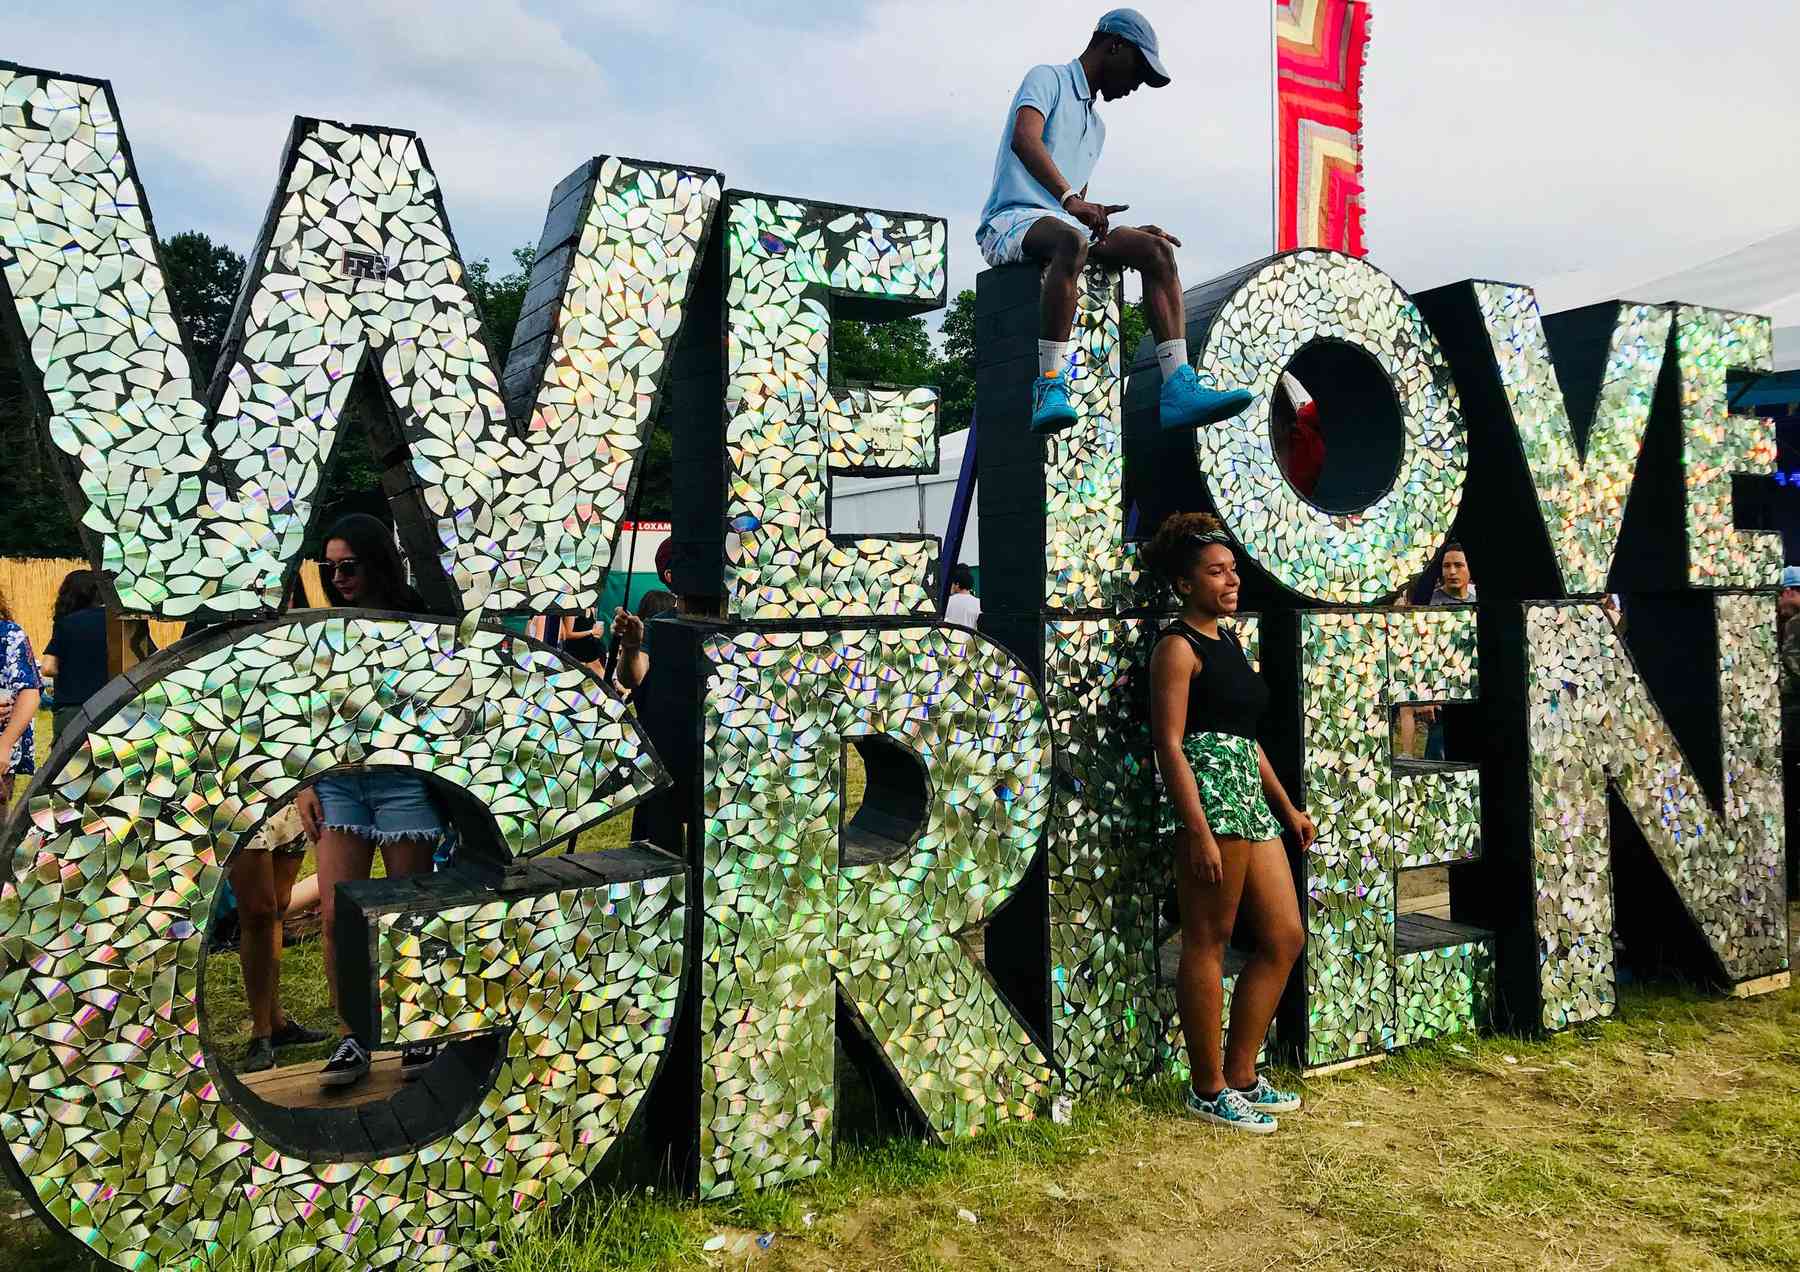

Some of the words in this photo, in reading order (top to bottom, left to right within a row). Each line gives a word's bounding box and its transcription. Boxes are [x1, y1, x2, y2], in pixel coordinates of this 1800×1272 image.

[0, 60, 948, 620] WE
[1042, 247, 1784, 612] LOVE
[638, 521, 672, 531] LOXAM
[0, 594, 1790, 1272] GREEN
